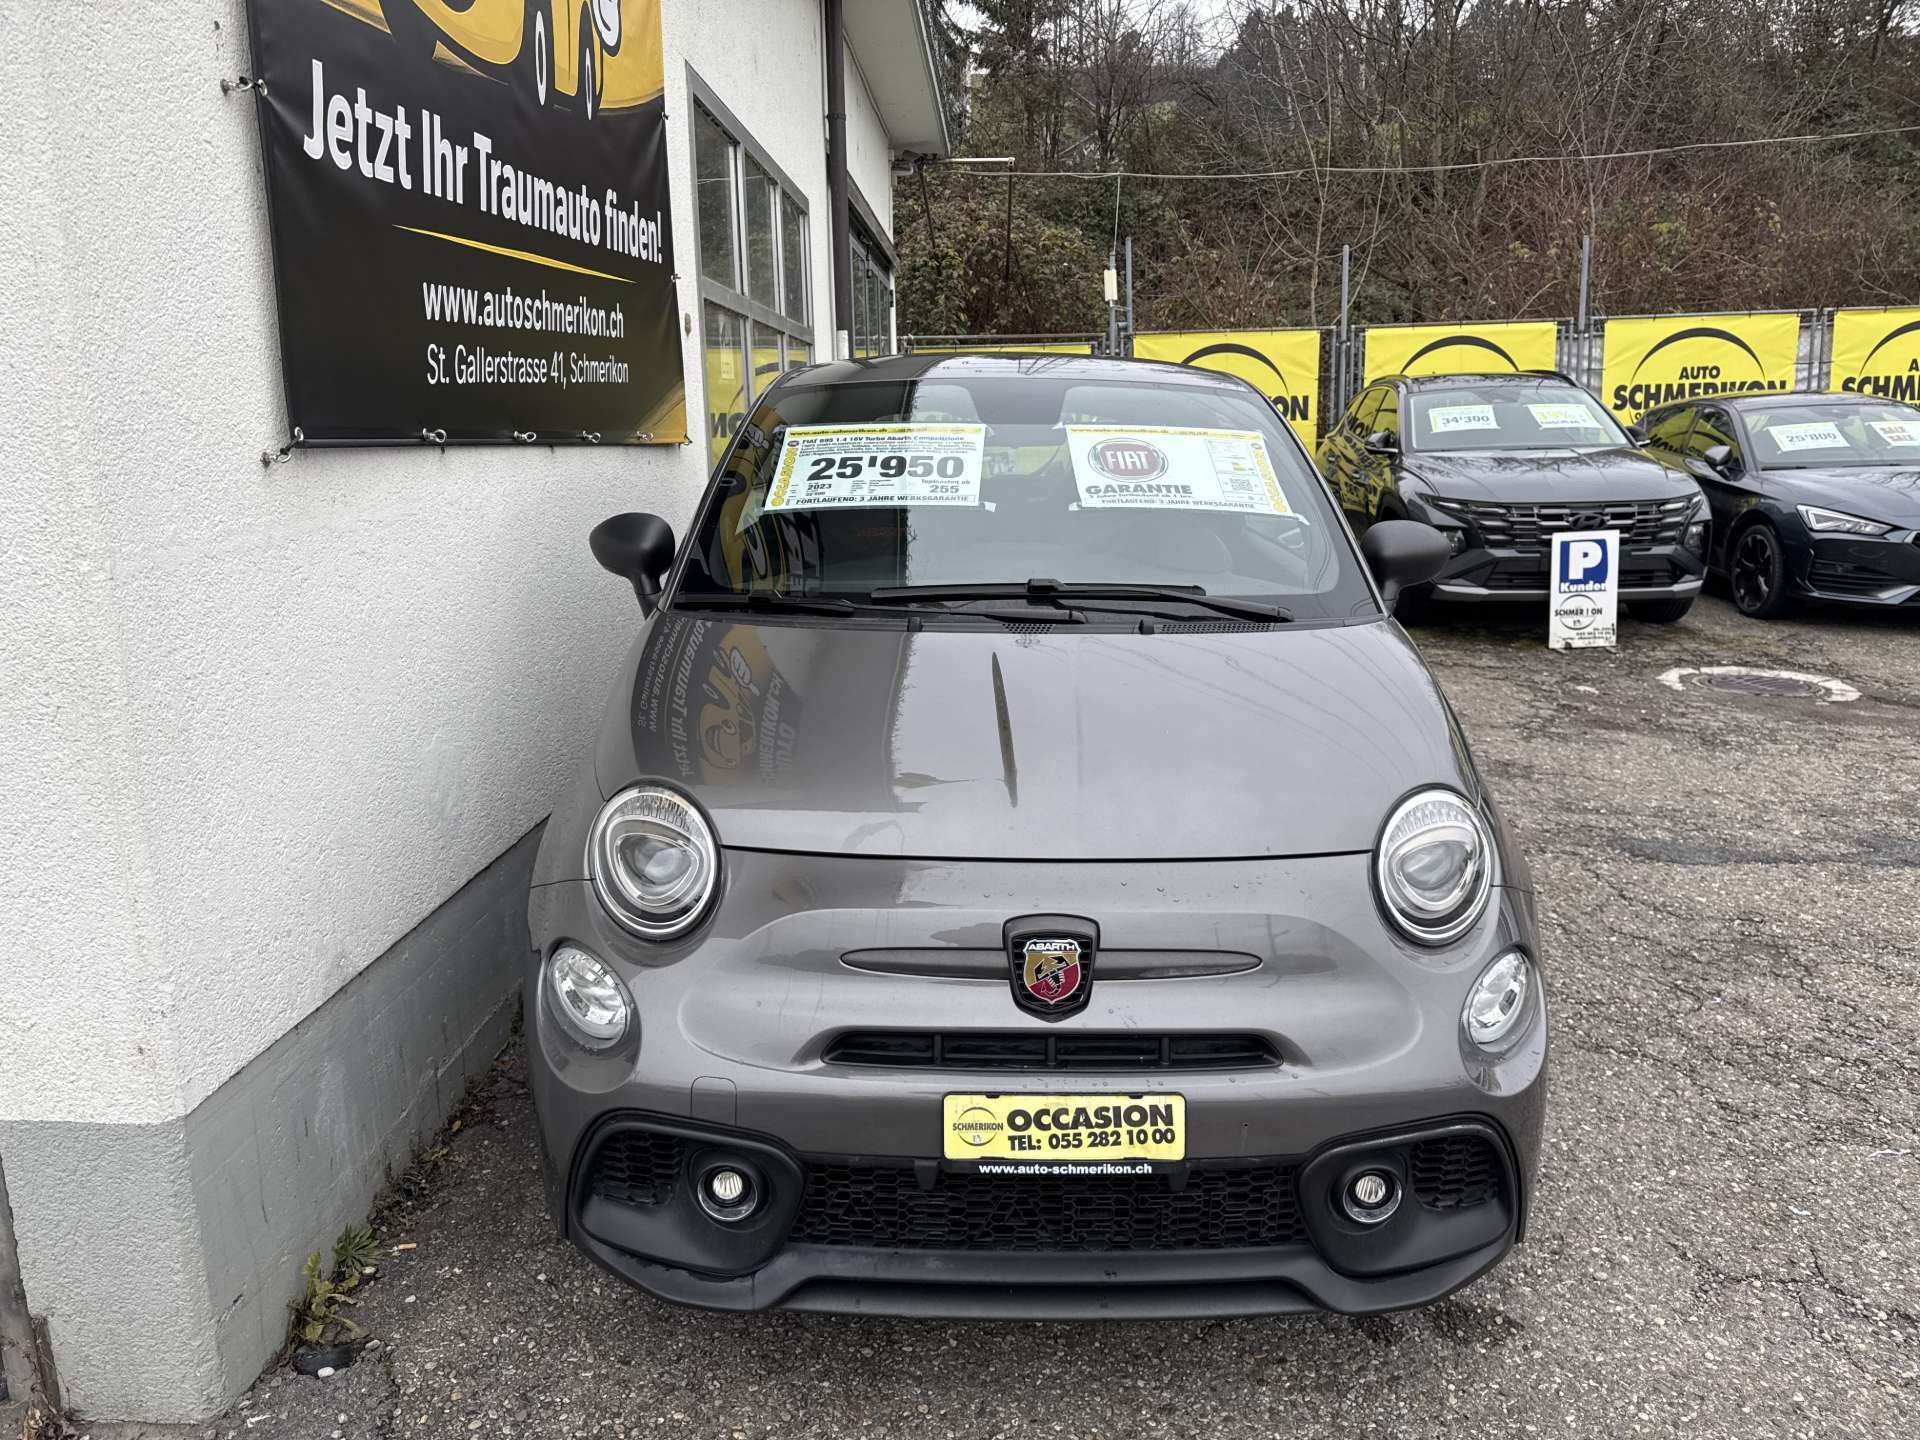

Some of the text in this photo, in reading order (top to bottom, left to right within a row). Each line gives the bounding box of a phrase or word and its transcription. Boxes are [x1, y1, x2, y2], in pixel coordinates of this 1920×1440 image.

[303, 58, 663, 264] Jetzt Ihr Traumauto finden!
[422, 281, 625, 339] www.autoschmerikon.ch
[426, 343, 629, 390] St. Gallerstrasse 41, Schmerikon
[1679, 366, 1720, 380] AUTO
[806, 455, 965, 482] 25'950
[1104, 450, 1149, 470] FIAT
[807, 483, 832, 491] 2023
[929, 485, 960, 493] 255
[1085, 484, 1193, 495] GARANTIE
[796, 496, 857, 505] FORTLAUFEND:
[1568, 541, 1603, 580] P
[1028, 942, 1076, 951] ABARTH
[1006, 1103, 1174, 1132] OCCASION
[952, 1122, 1003, 1131] SCHMERIKON
[1008, 1128, 1175, 1151] TEL: 055 282 10 00
[978, 1163, 1152, 1175] www.auto-schmerikon.ch
